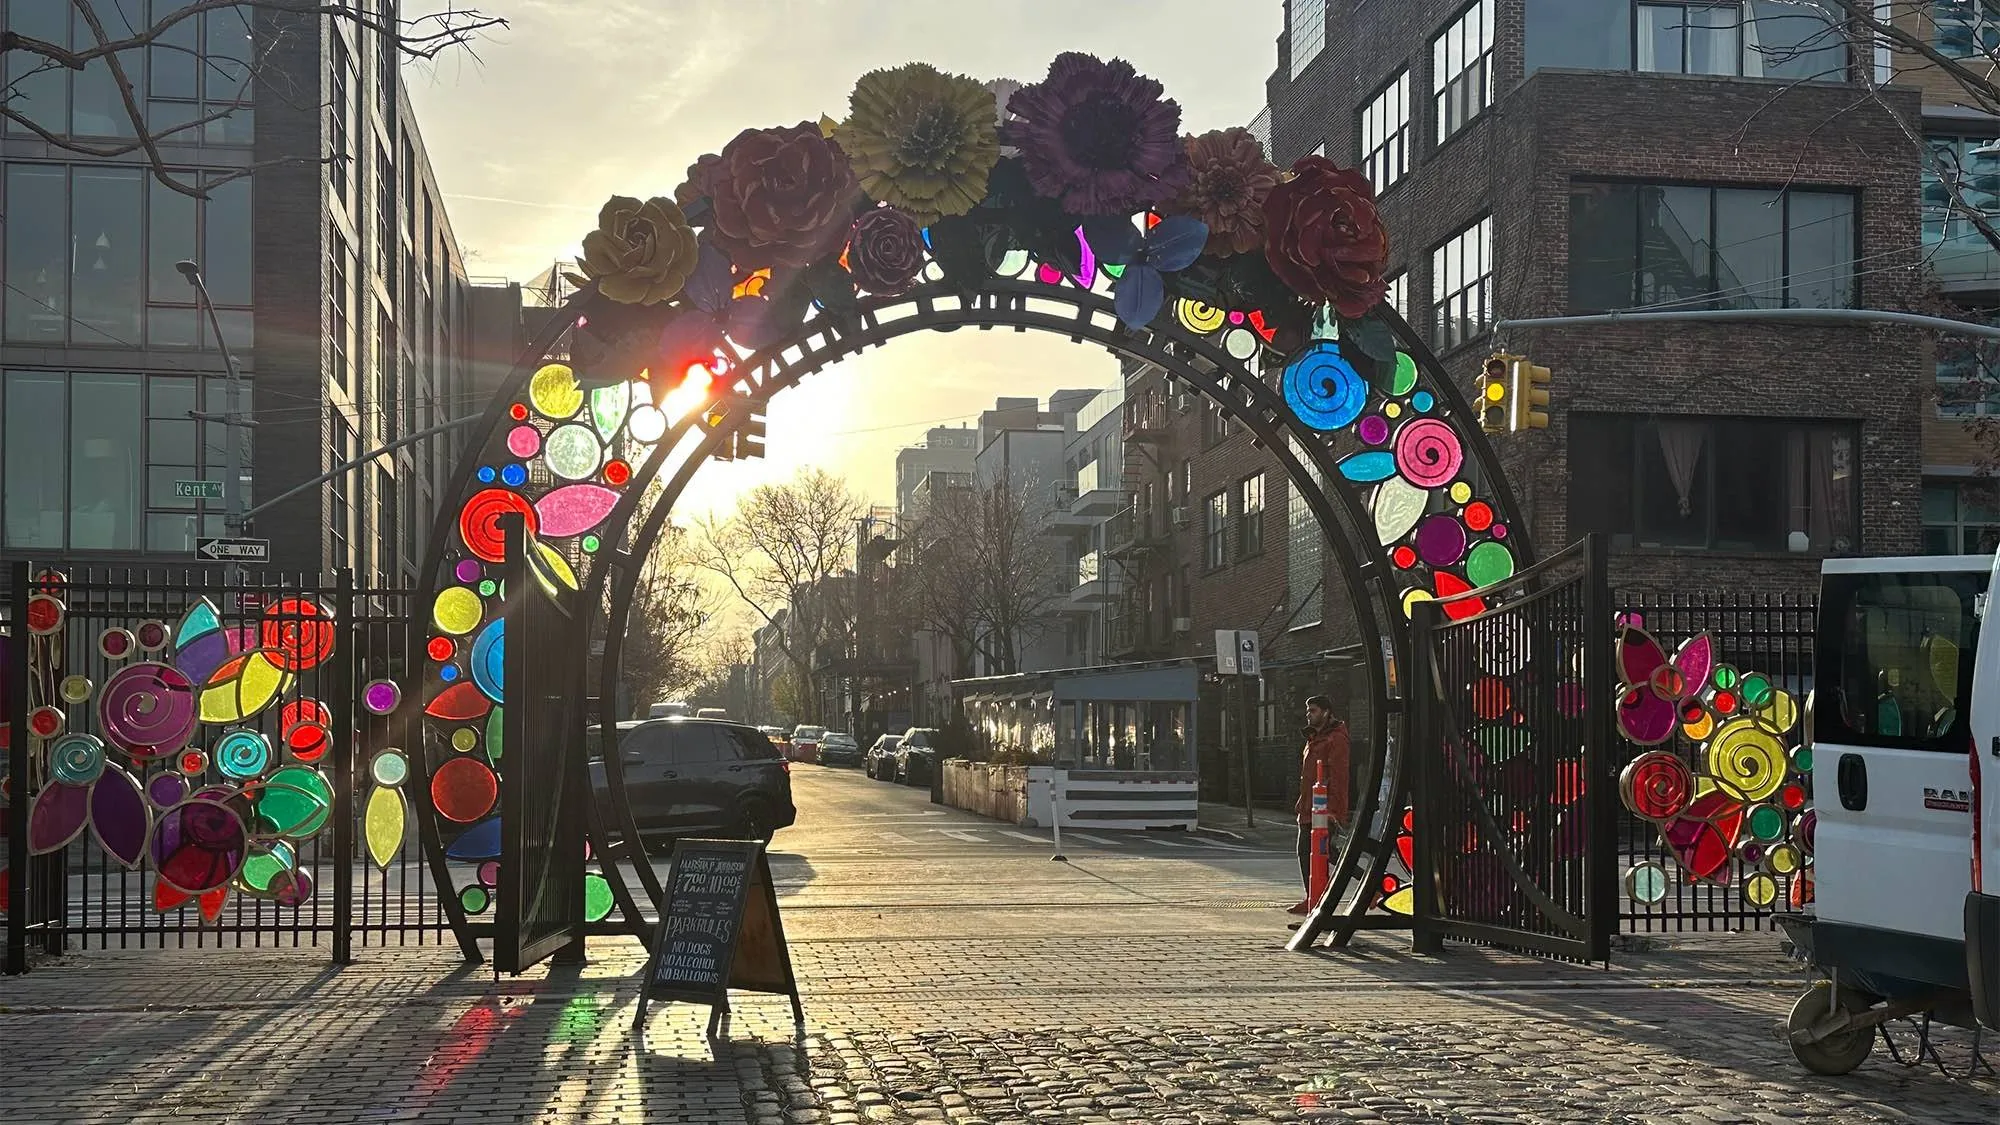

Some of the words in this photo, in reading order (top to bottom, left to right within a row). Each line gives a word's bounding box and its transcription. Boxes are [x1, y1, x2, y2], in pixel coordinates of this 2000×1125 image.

[176, 483, 206, 496] Kent
[210, 545, 230, 554] ONE
[239, 545, 261, 555] WAY
[671, 941, 685, 953] NO
[687, 942, 712, 955] DOGS
[660, 953, 675, 966] NO
[675, 954, 716, 970] ALCOHOL
[657, 967, 672, 980] NO
[672, 968, 719, 984] BALLOONS
